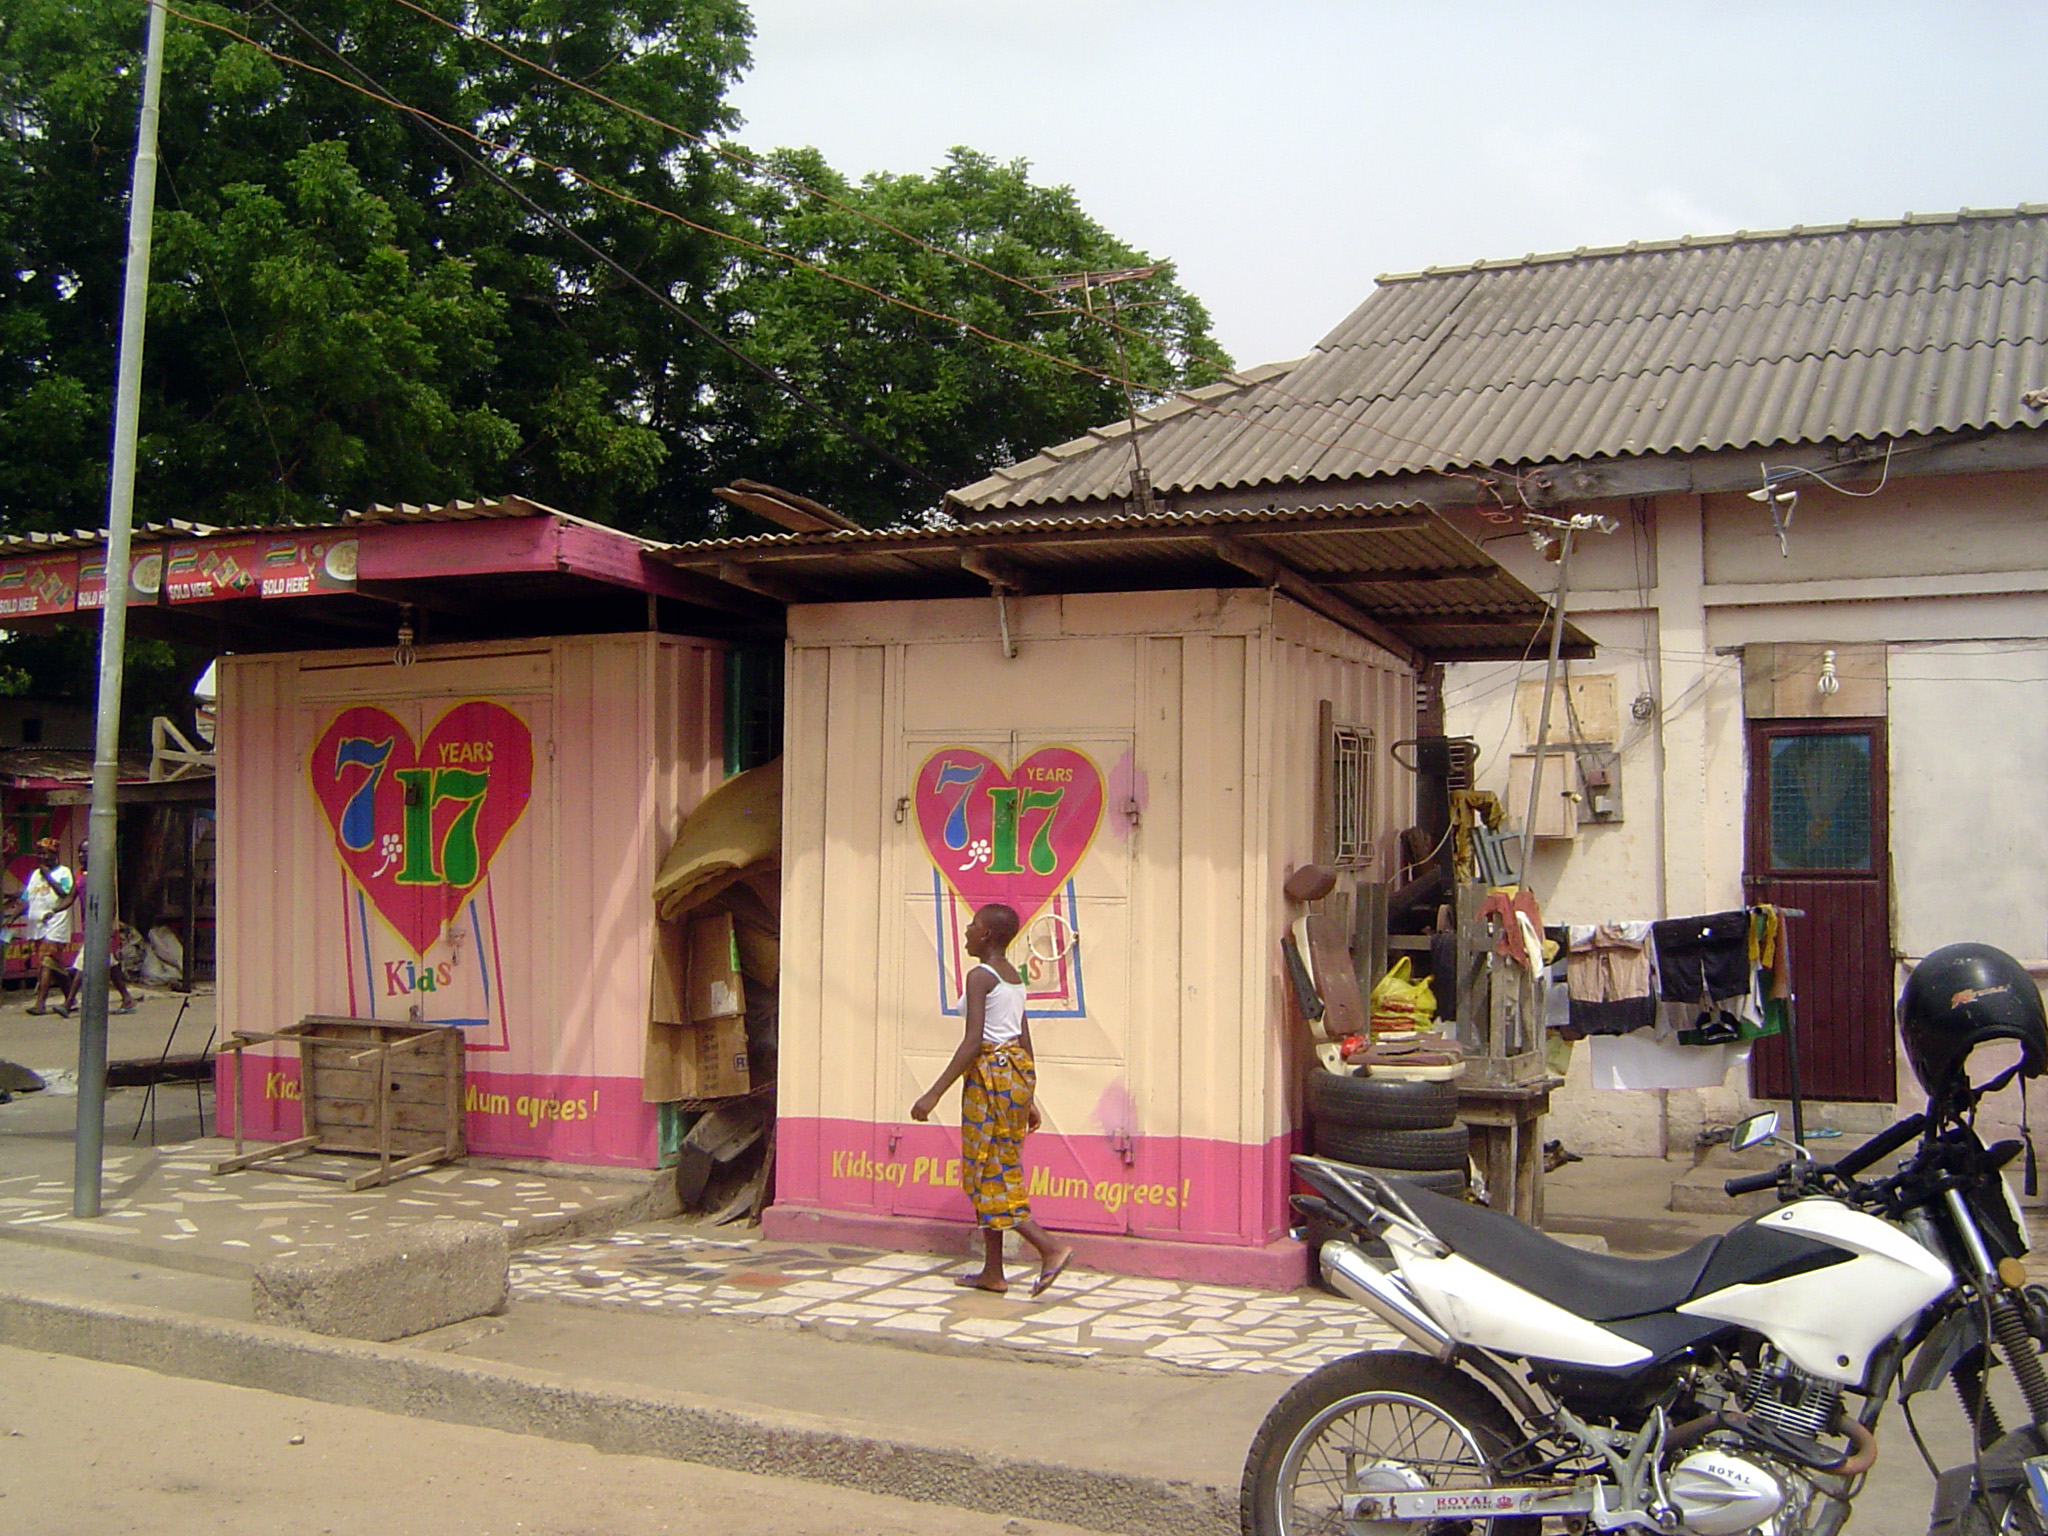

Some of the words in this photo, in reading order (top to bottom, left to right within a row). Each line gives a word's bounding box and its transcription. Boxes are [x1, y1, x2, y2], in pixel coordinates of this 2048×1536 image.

[168, 583, 190, 600] SOLD
[191, 581, 215, 597] HERE
[262, 578, 285, 595] SOLD
[286, 576, 310, 593] HERE
[78, 591, 98, 606] SOLD
[439, 741, 494, 763] YEARS
[1027, 767, 1073, 782] YEARS
[384, 960, 452, 996] Kids
[465, 1084, 510, 1115] Mum
[912, 1156, 963, 1187] PLE
[1027, 1165, 1088, 1199] Mum
[1093, 1178, 1190, 1213] agrees!
[1708, 1464, 1750, 1485] ROYAL
[1436, 1496, 1492, 1506] ROYAL
